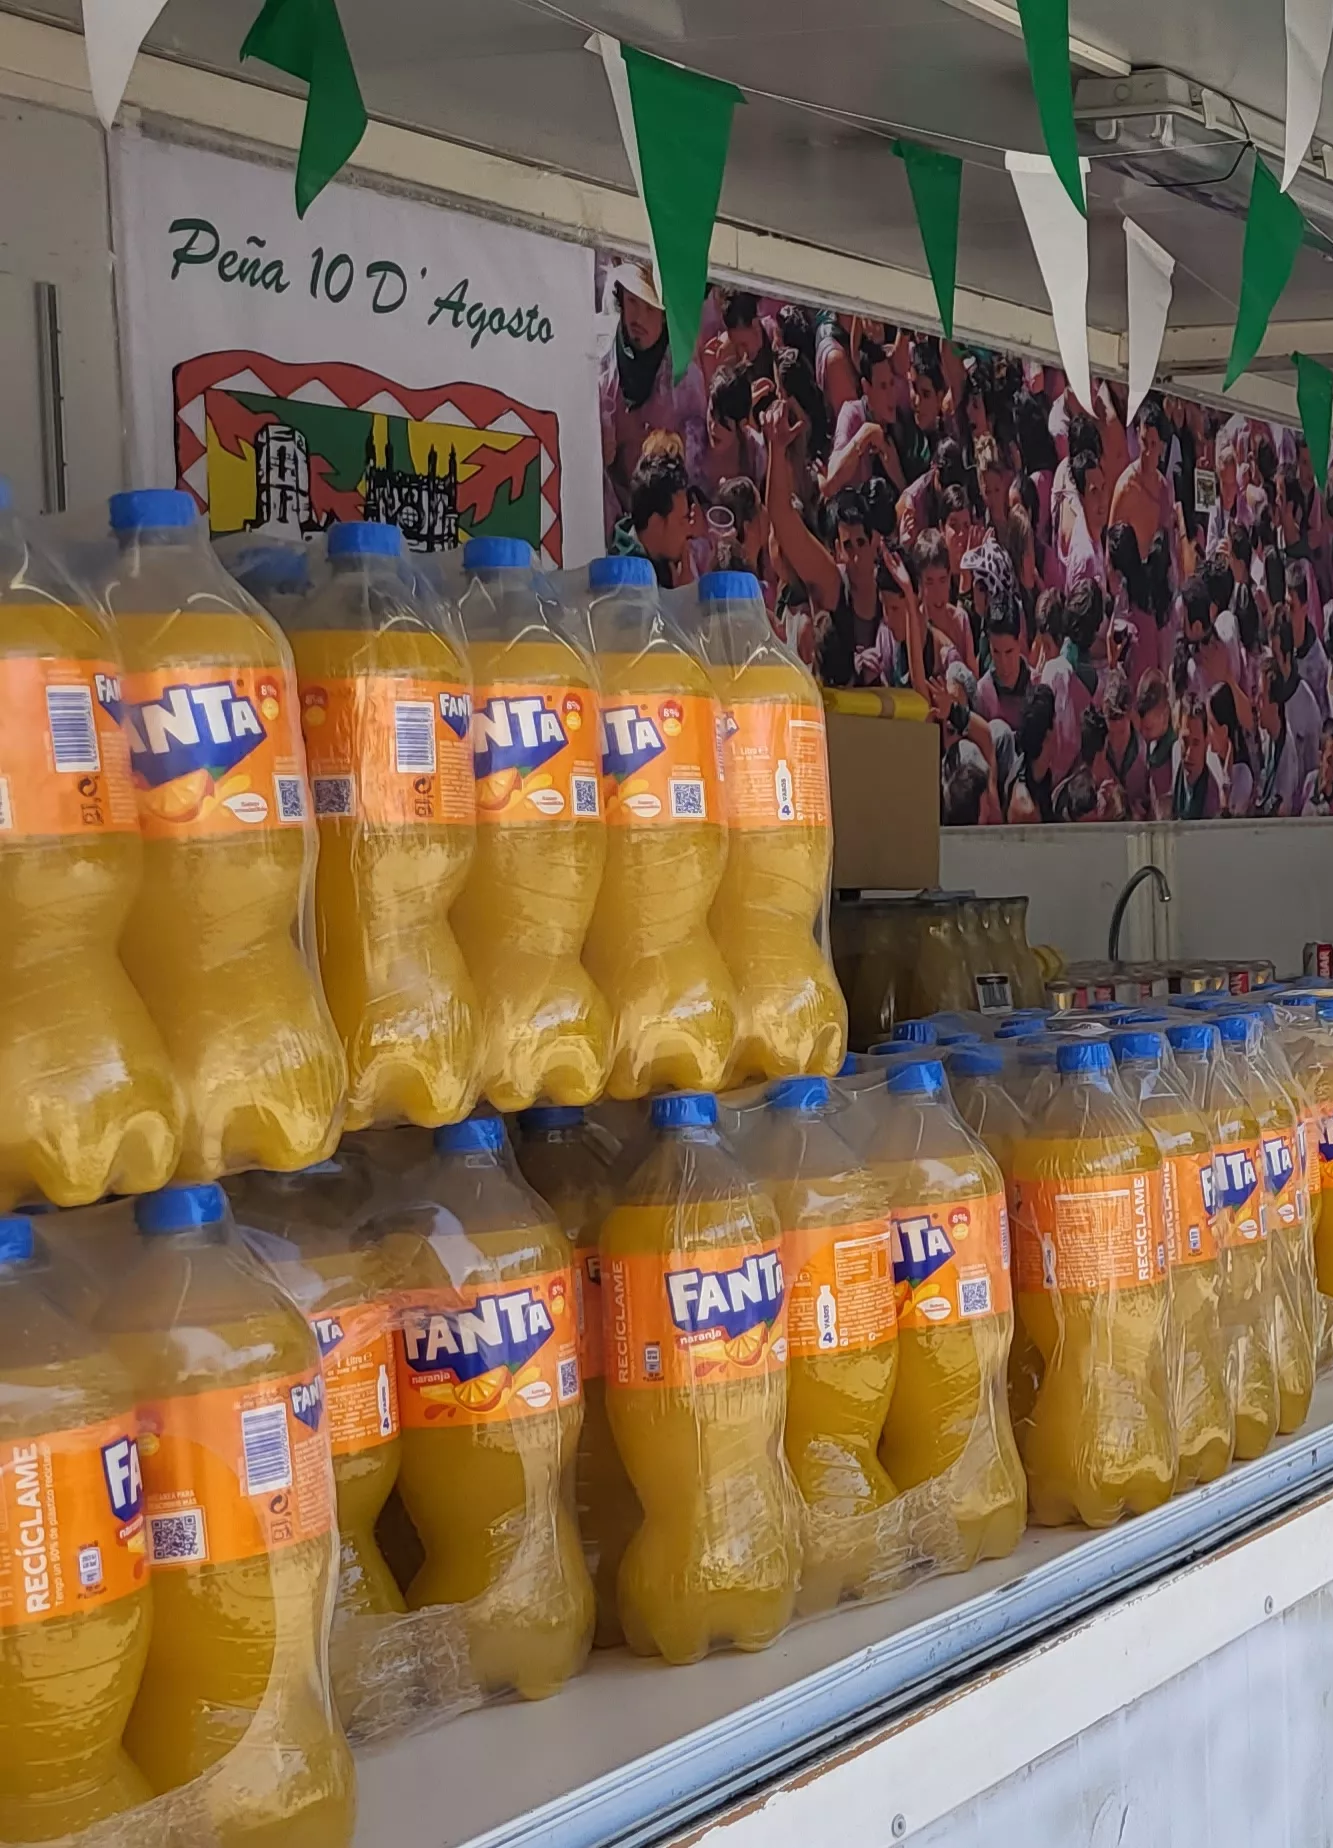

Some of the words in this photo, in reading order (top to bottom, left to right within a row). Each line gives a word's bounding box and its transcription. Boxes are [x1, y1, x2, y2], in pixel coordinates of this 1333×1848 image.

[169, 218, 291, 296] Peña
[310, 247, 355, 304] 10
[428, 279, 555, 348] Agosto
[1134, 1176, 1149, 1280] RECÍCLAME
[402, 1292, 551, 1361] FANTA
[611, 1260, 629, 1384] RECÍCLAME
[679, 1329, 722, 1345] naranja
[412, 1371, 451, 1384] naranja
[13, 1443, 50, 1613] RECÍCLAME
